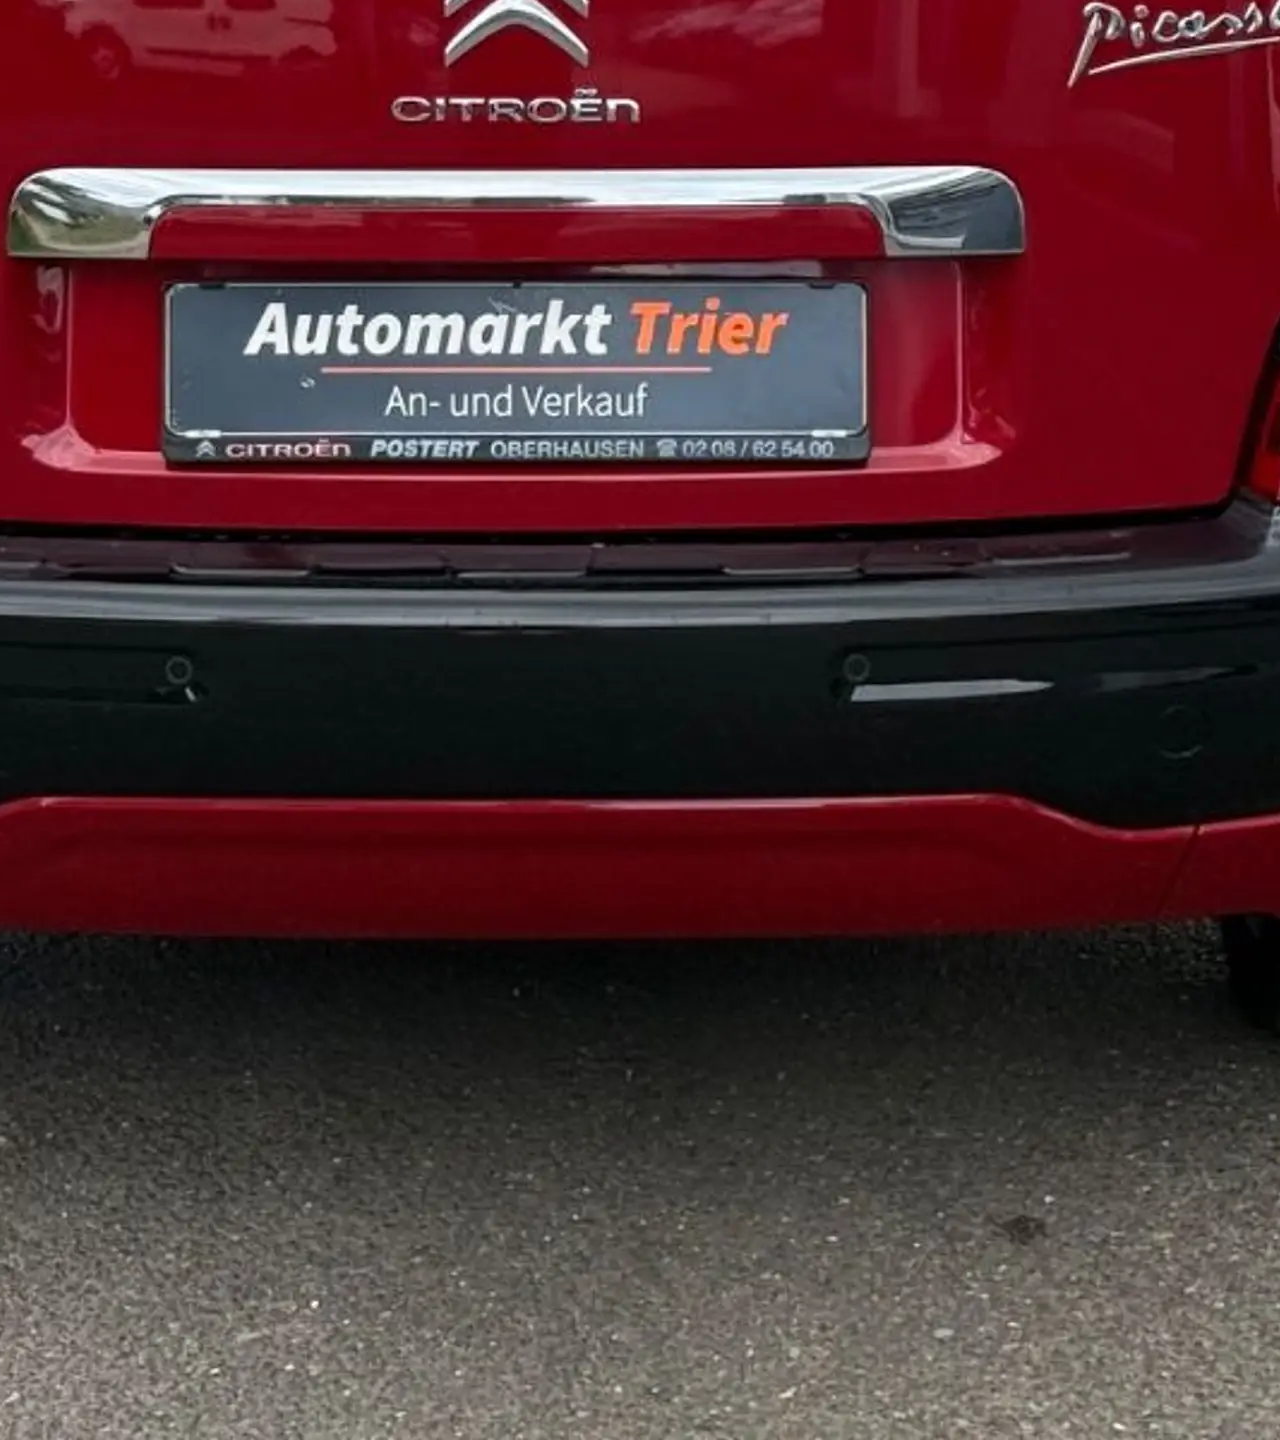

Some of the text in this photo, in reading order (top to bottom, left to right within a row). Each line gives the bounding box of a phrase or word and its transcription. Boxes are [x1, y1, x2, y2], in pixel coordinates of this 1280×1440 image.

[243, 296, 789, 356] Automarkt Trier
[384, 381, 649, 417] An- und Verkauf
[370, 439, 480, 458] POSTERT
[490, 439, 644, 459] OBERHAUSEN
